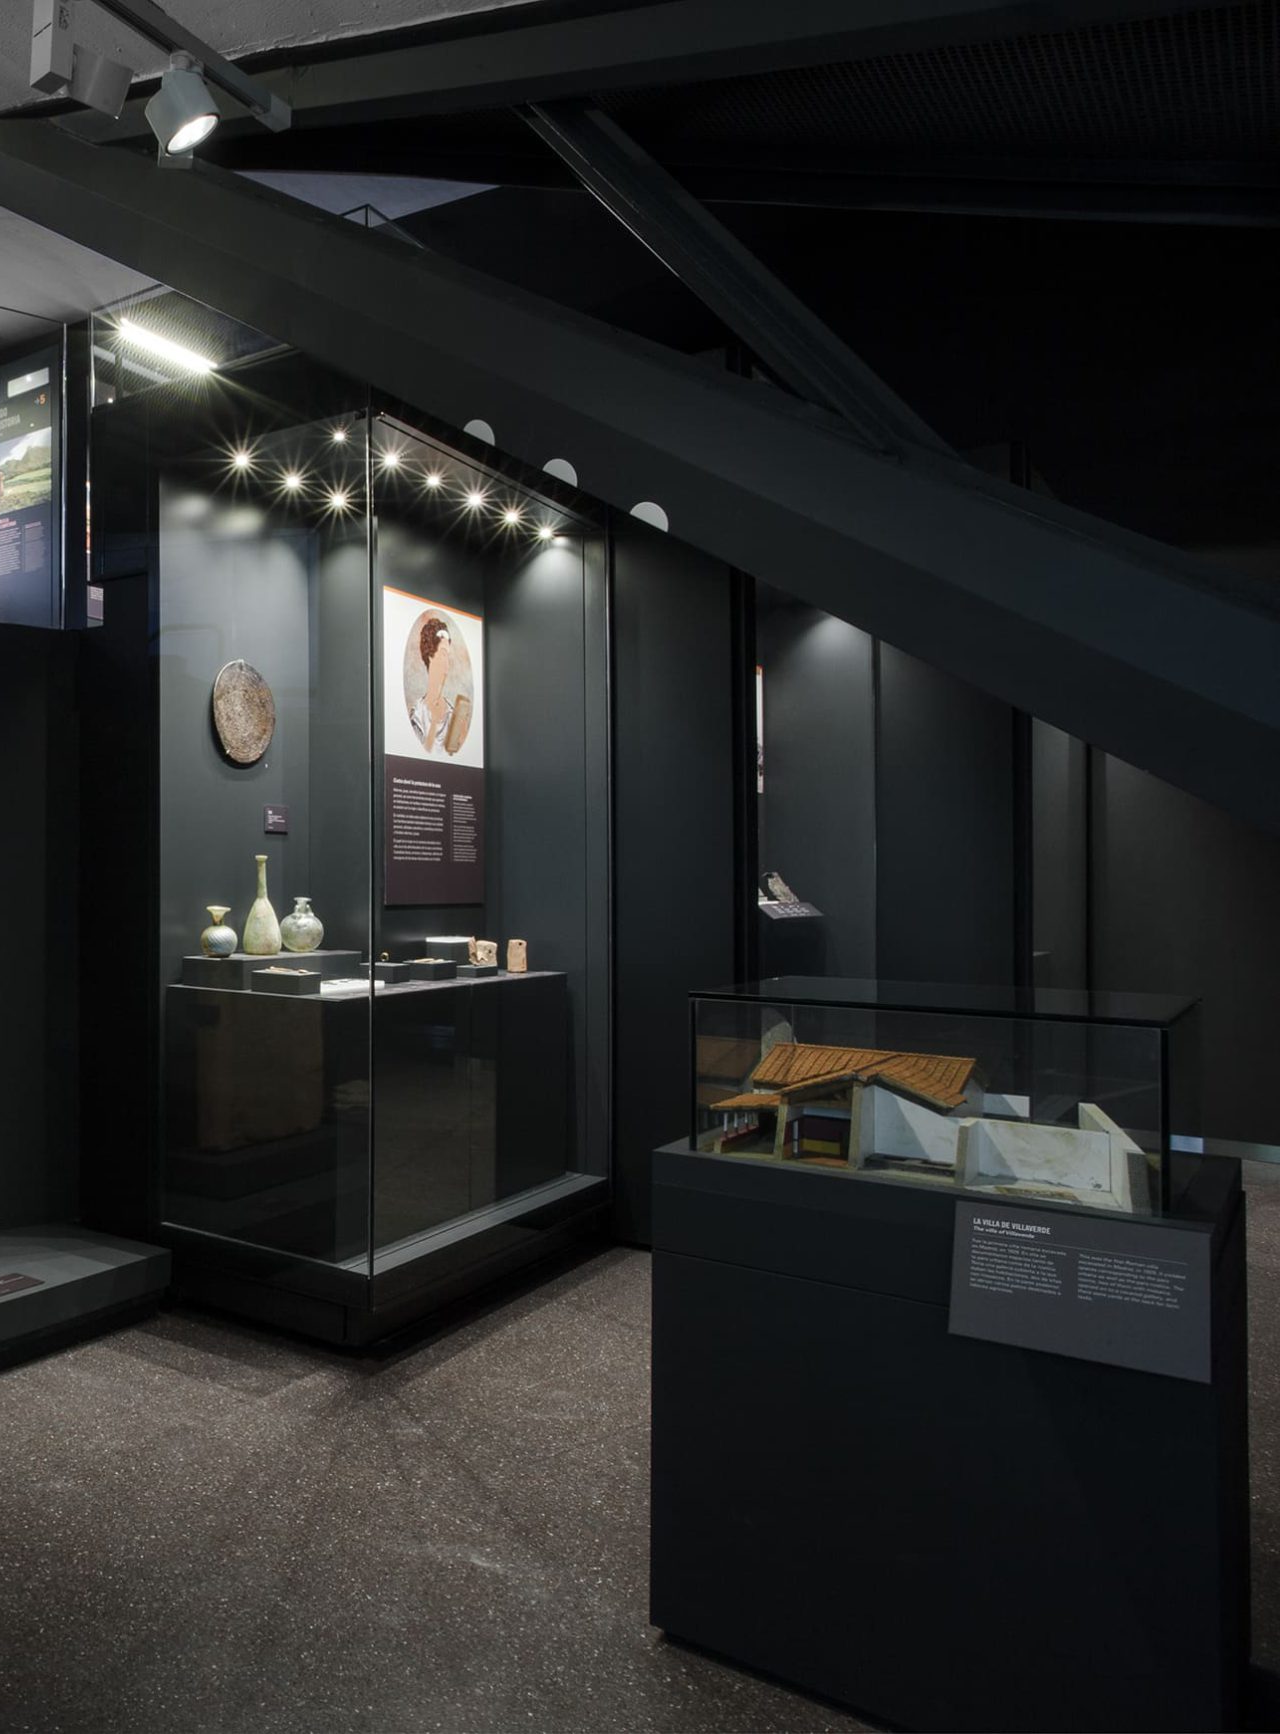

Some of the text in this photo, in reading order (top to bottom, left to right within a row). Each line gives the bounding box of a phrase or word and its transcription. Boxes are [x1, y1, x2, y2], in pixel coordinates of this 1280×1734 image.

[973, 1217, 1052, 1235] LA VILLA DE VILLAVERDE
